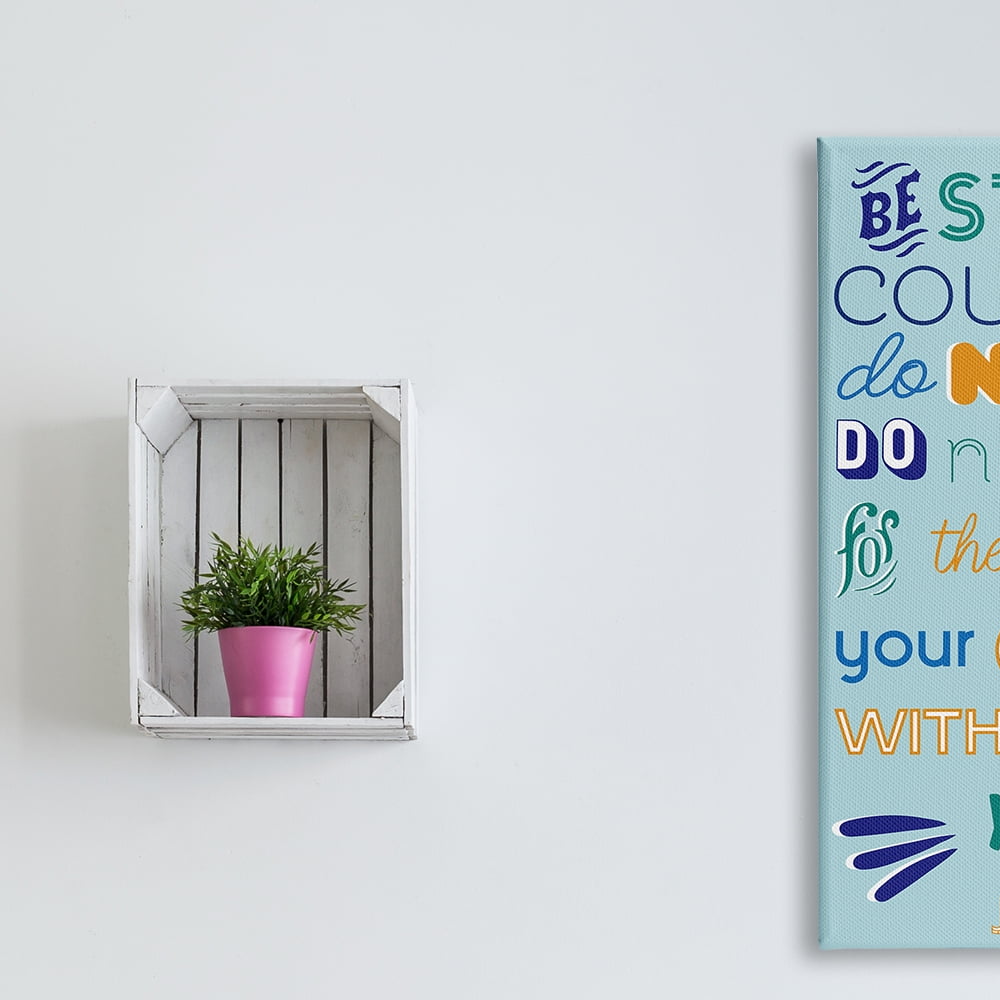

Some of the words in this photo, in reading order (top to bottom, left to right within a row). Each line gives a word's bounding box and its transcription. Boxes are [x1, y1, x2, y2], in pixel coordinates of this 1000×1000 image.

[858, 169, 924, 242] BE
[836, 331, 938, 401] do
[835, 416, 928, 482] DO
[835, 629, 975, 685] your
